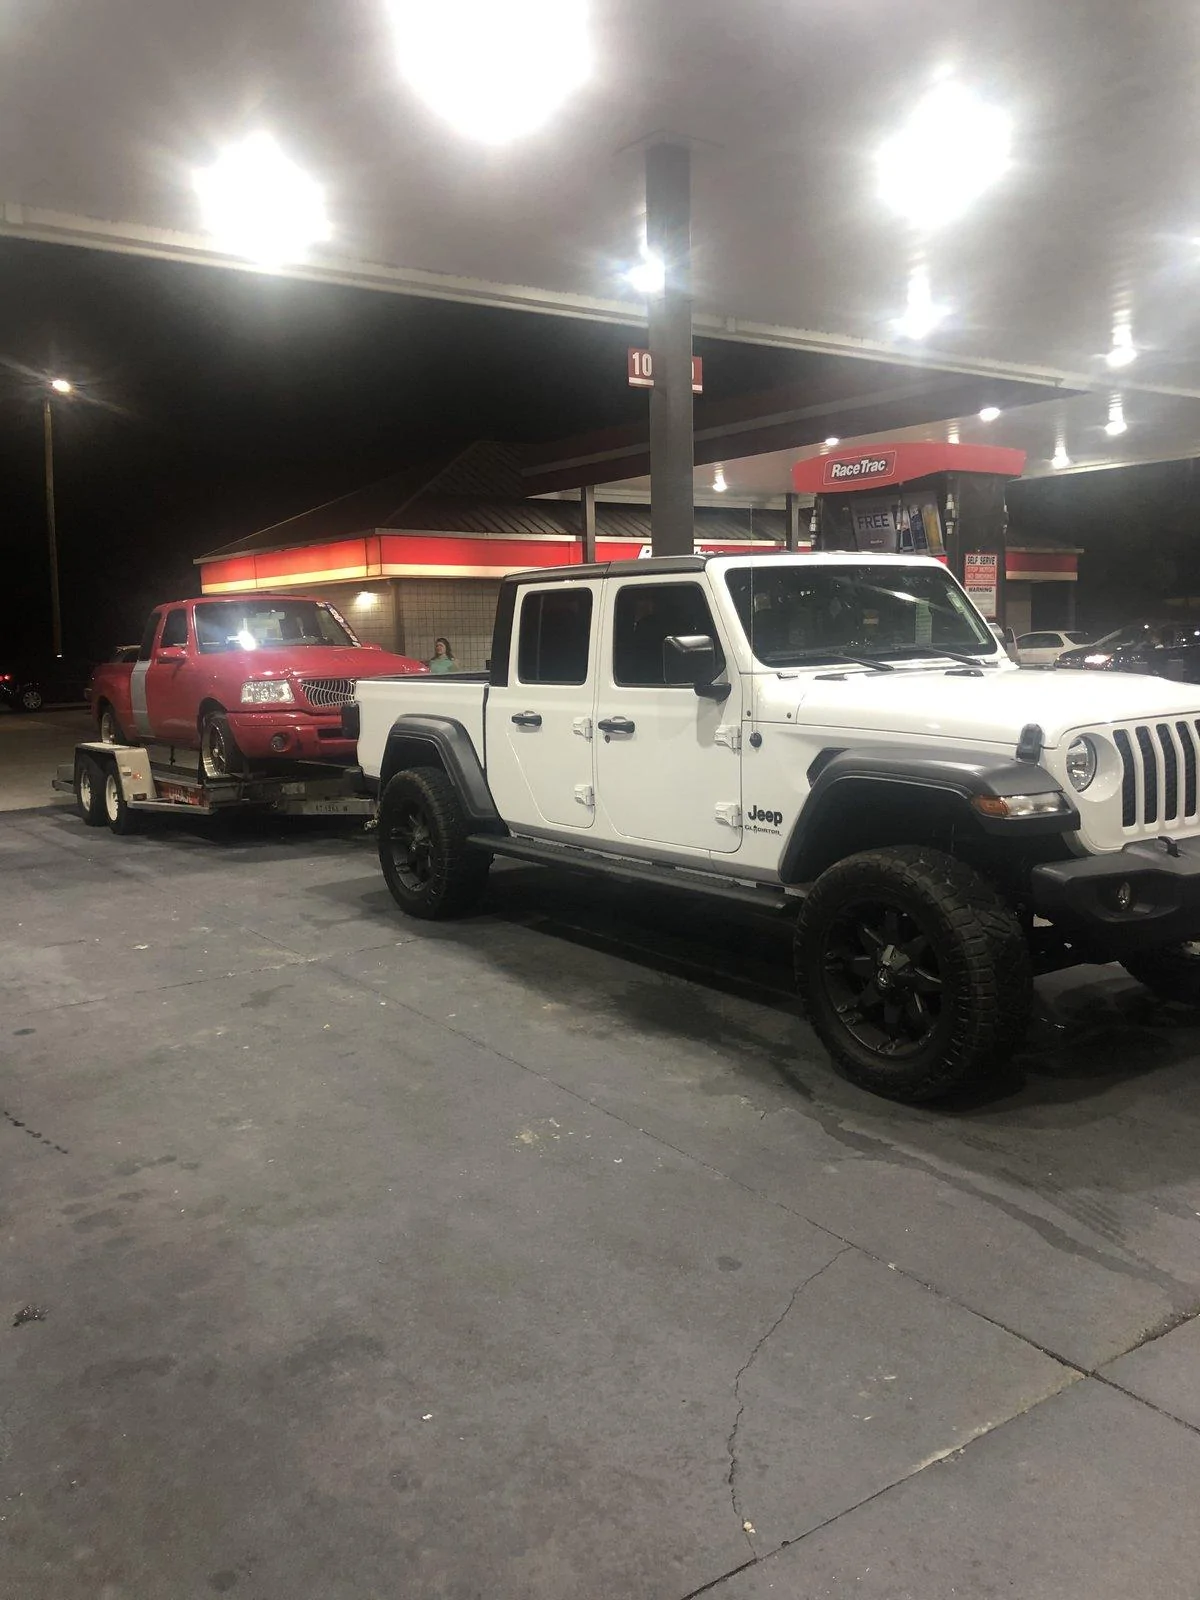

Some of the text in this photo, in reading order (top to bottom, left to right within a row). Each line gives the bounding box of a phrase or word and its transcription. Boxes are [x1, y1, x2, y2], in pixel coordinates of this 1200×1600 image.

[632, 352, 653, 377] 10
[831, 459, 886, 477] RaceTrac
[857, 513, 890, 529] FREE
[967, 556, 995, 565] SELF SERVE
[747, 804, 783, 827] Jeep
